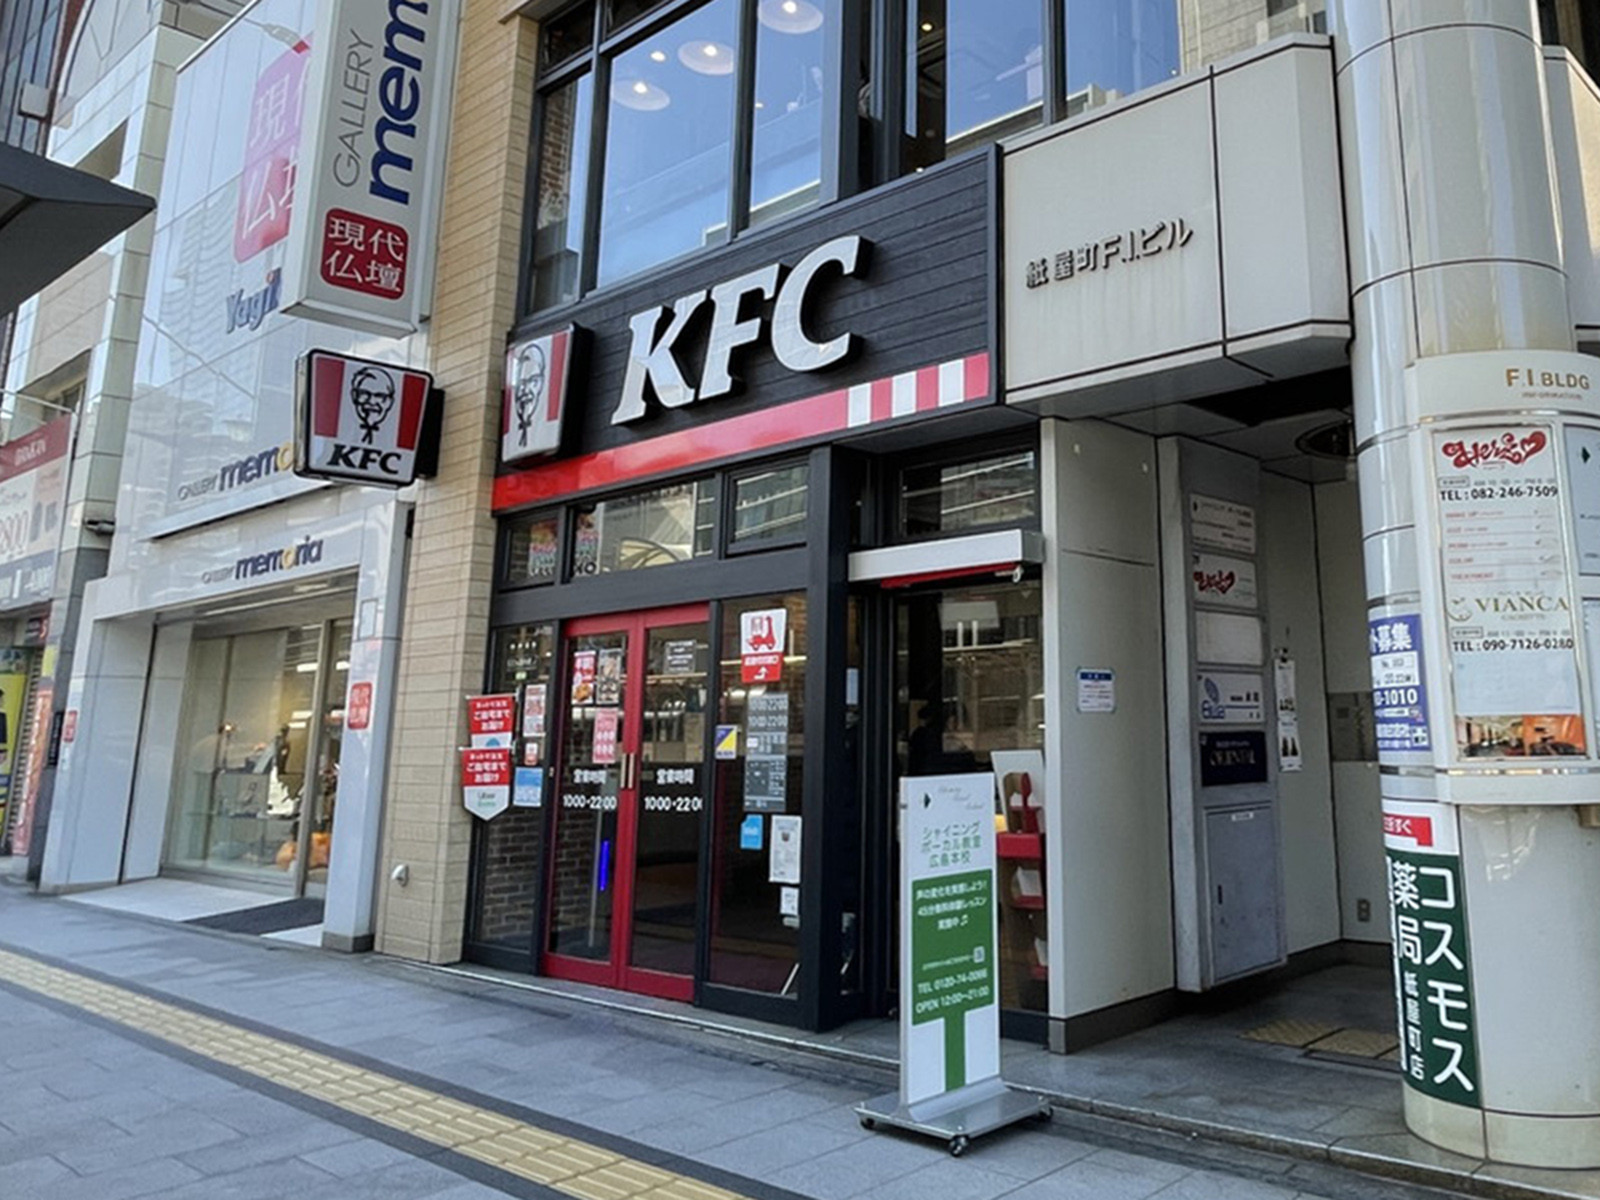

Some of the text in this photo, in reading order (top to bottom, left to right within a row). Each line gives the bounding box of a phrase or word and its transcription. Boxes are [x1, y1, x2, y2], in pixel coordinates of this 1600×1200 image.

[333, 28, 373, 188] GALLERY
[327, 218, 404, 262] 現代
[325, 249, 402, 292] 仏壇
[610, 234, 863, 426] KFC
[325, 443, 403, 475] KFC
[1470, 486, 1559, 500] 082-246-7509
[234, 534, 324, 581] memoria
[1475, 596, 1570, 613] VIANCA
[1392, 860, 1422, 965] 薬局
[918, 981, 933, 994] TEL
[1419, 866, 1475, 1092] コスモス
[916, 998, 940, 1014] OPEN
